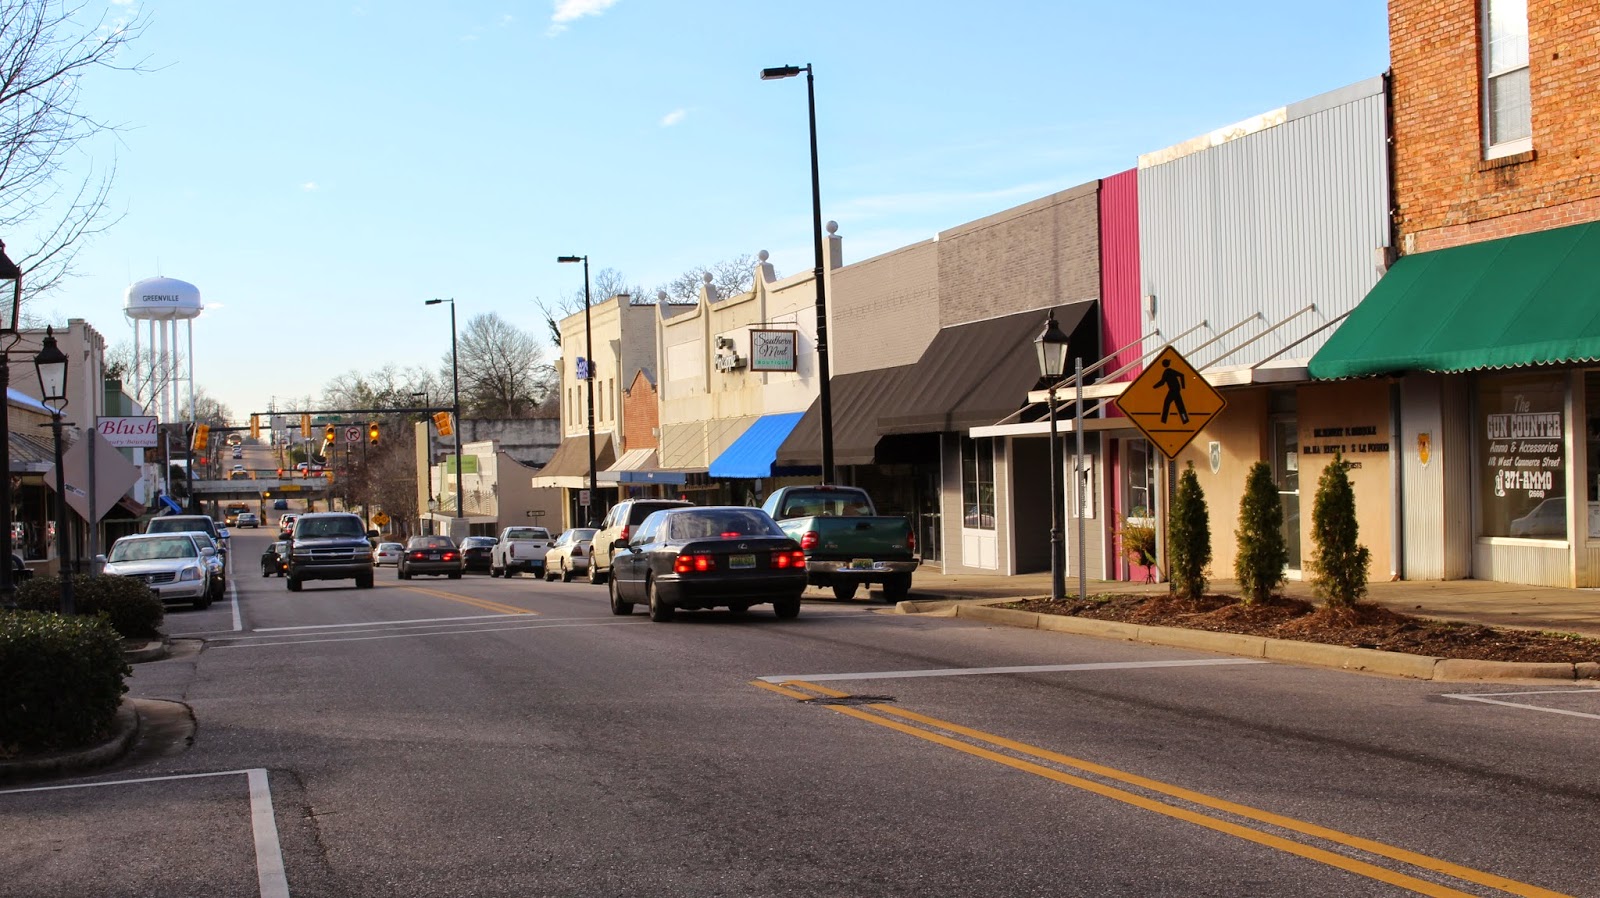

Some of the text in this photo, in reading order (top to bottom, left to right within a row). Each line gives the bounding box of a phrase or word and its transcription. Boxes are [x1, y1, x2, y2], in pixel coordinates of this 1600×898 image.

[142, 294, 180, 302] GREENVILLE
[754, 332, 793, 347] Southern
[759, 344, 788, 357] Mint
[1513, 394, 1531, 413] The
[98, 418, 158, 435] Blush
[1487, 413, 1561, 440] GUN COUNTER
[1490, 440, 1509, 453] Ammo
[1519, 441, 1559, 453] Accessories
[1497, 456, 1513, 467] West
[1514, 456, 1541, 467] Commerce
[1542, 456, 1561, 467] Street
[1504, 470, 1553, 490] 371-AMMO
